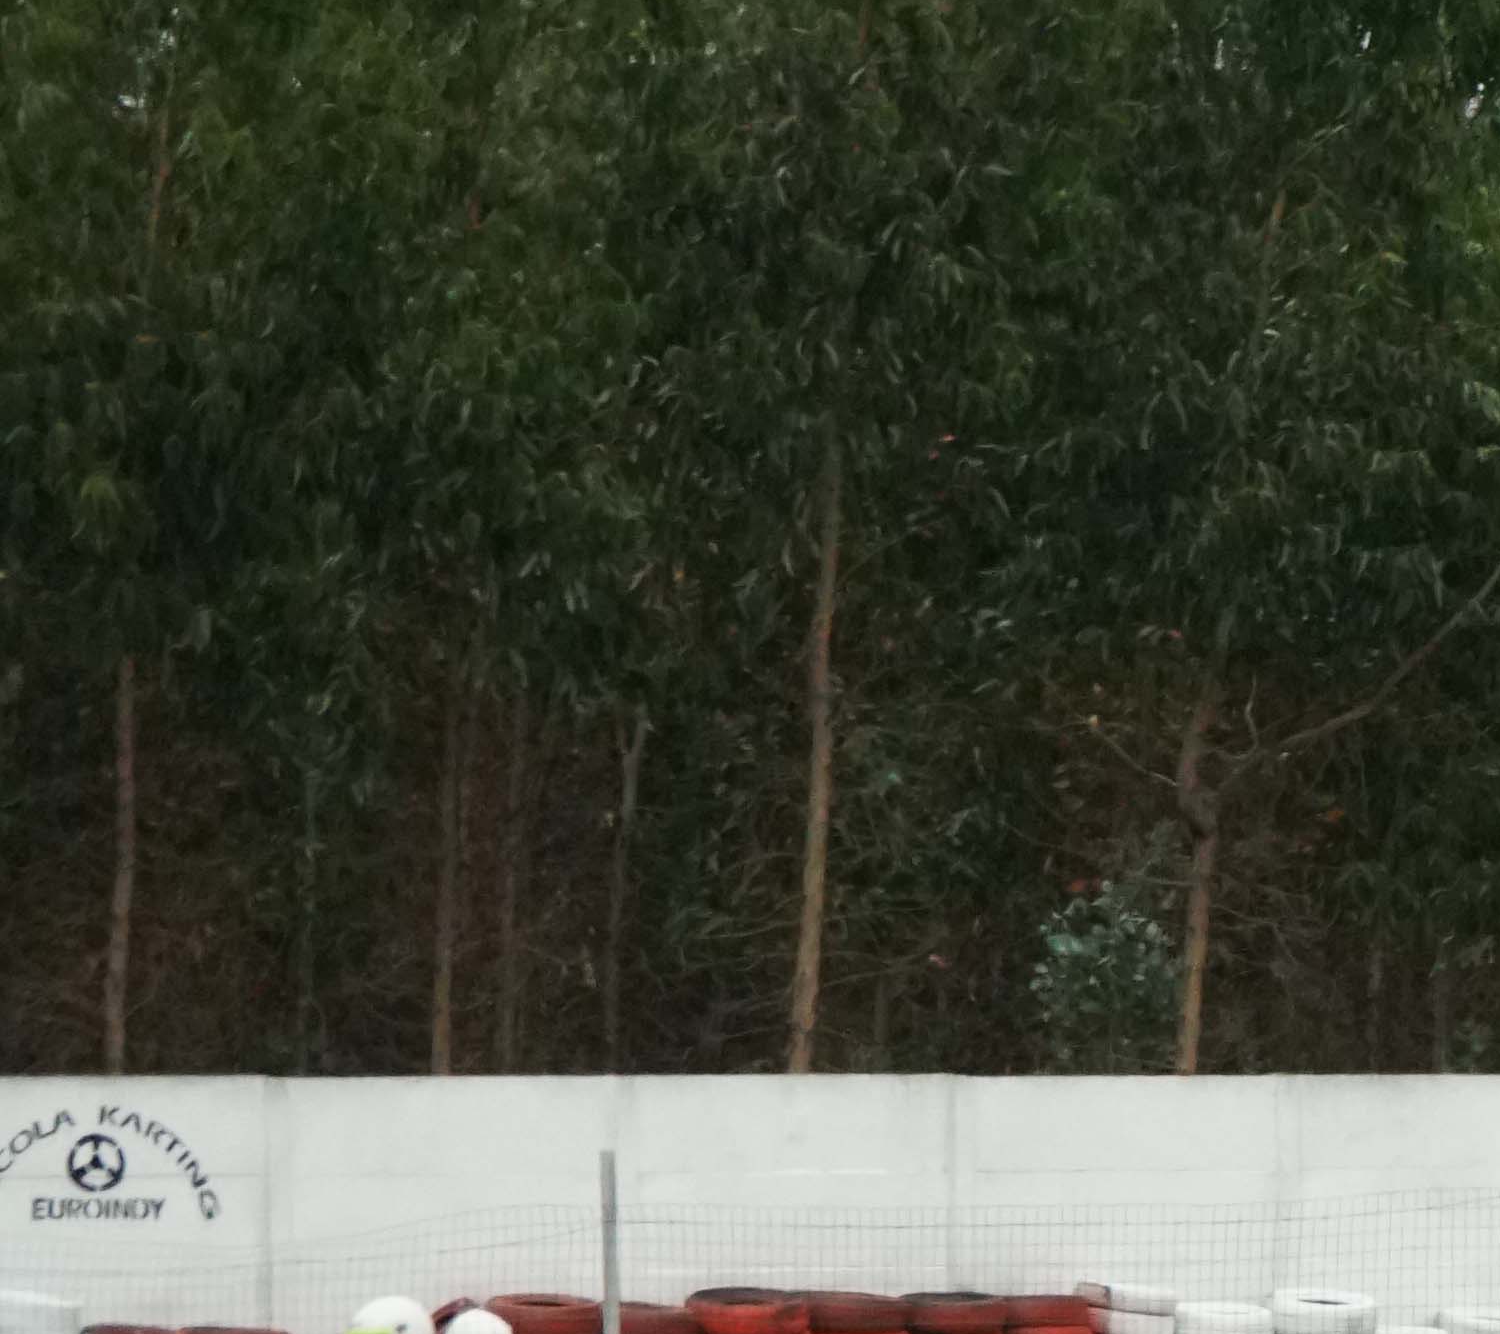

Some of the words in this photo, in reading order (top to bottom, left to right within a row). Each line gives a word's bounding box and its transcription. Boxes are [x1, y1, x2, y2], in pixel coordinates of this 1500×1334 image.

[0, 1109, 75, 1174] COLA
[98, 1104, 219, 1220] KARTING
[31, 1197, 166, 1221] EUROINDY
